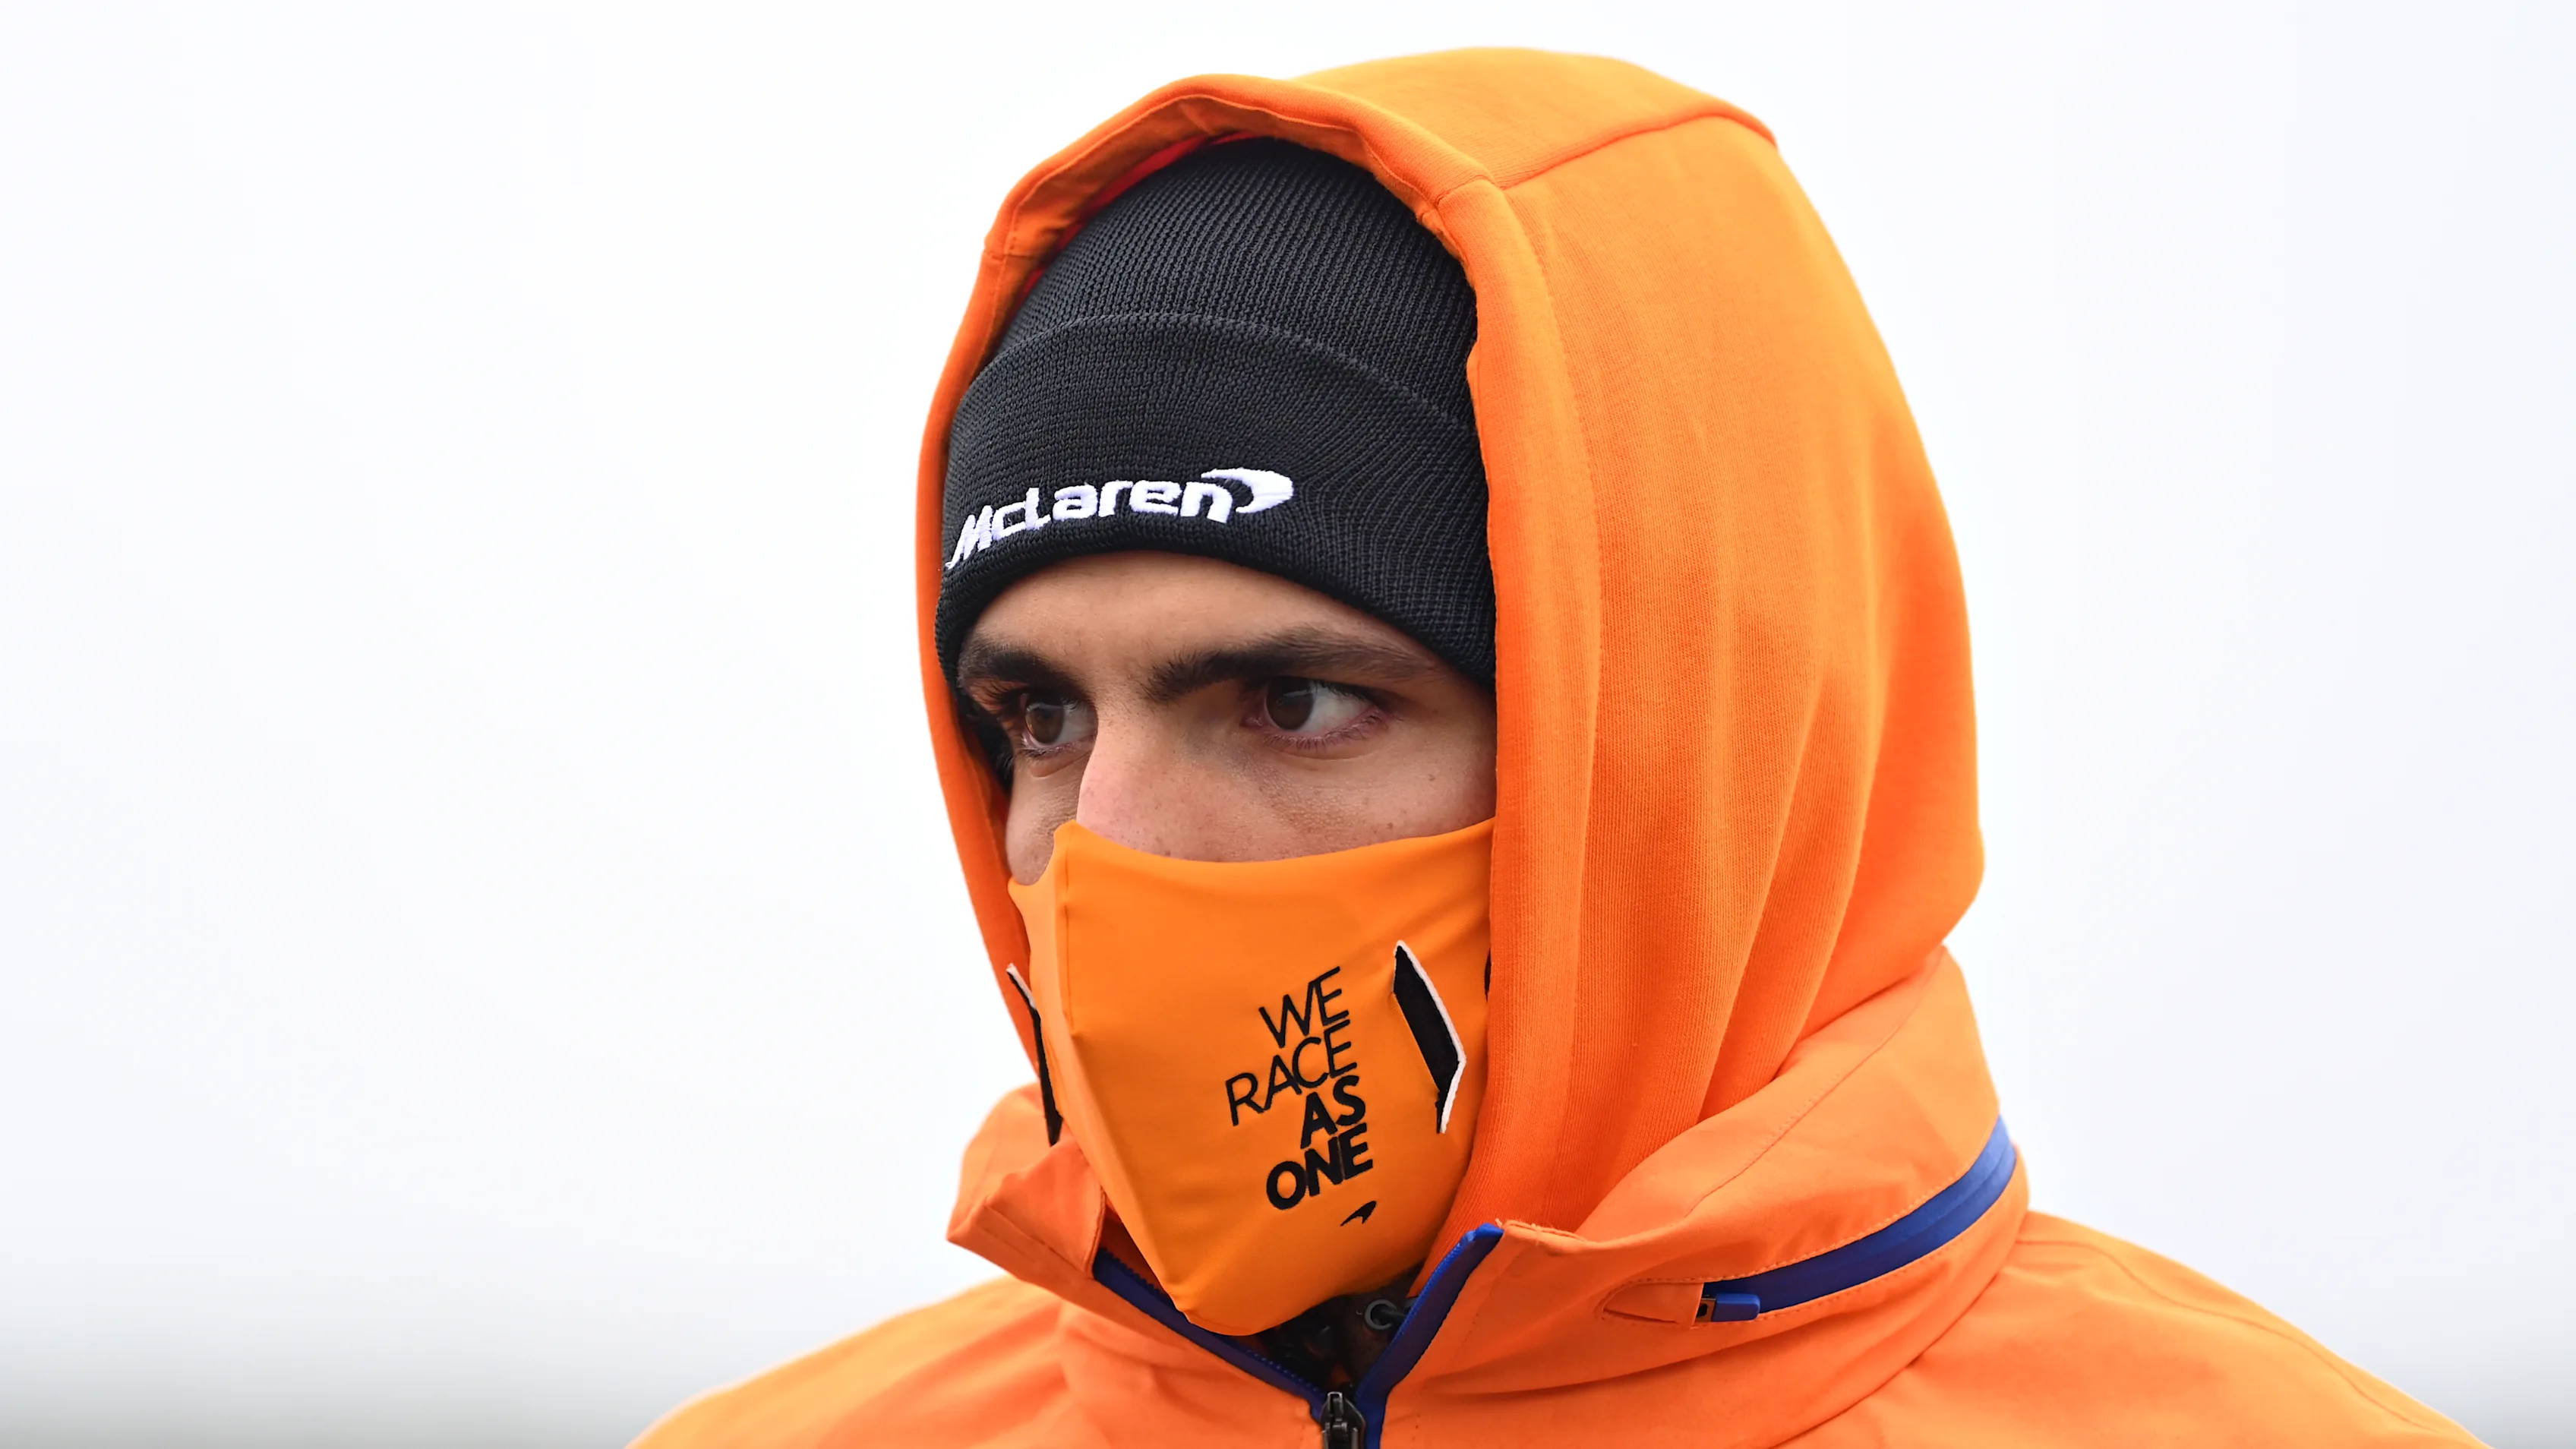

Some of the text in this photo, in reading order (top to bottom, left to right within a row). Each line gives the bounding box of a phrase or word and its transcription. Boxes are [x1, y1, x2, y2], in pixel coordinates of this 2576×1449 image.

[945, 480, 1233, 570] McLaren
[1258, 965, 1350, 1049] WE
[1225, 1018, 1358, 1126] RACE
[1300, 1075, 1366, 1150] AS
[1266, 1122, 1374, 1211] ONE
